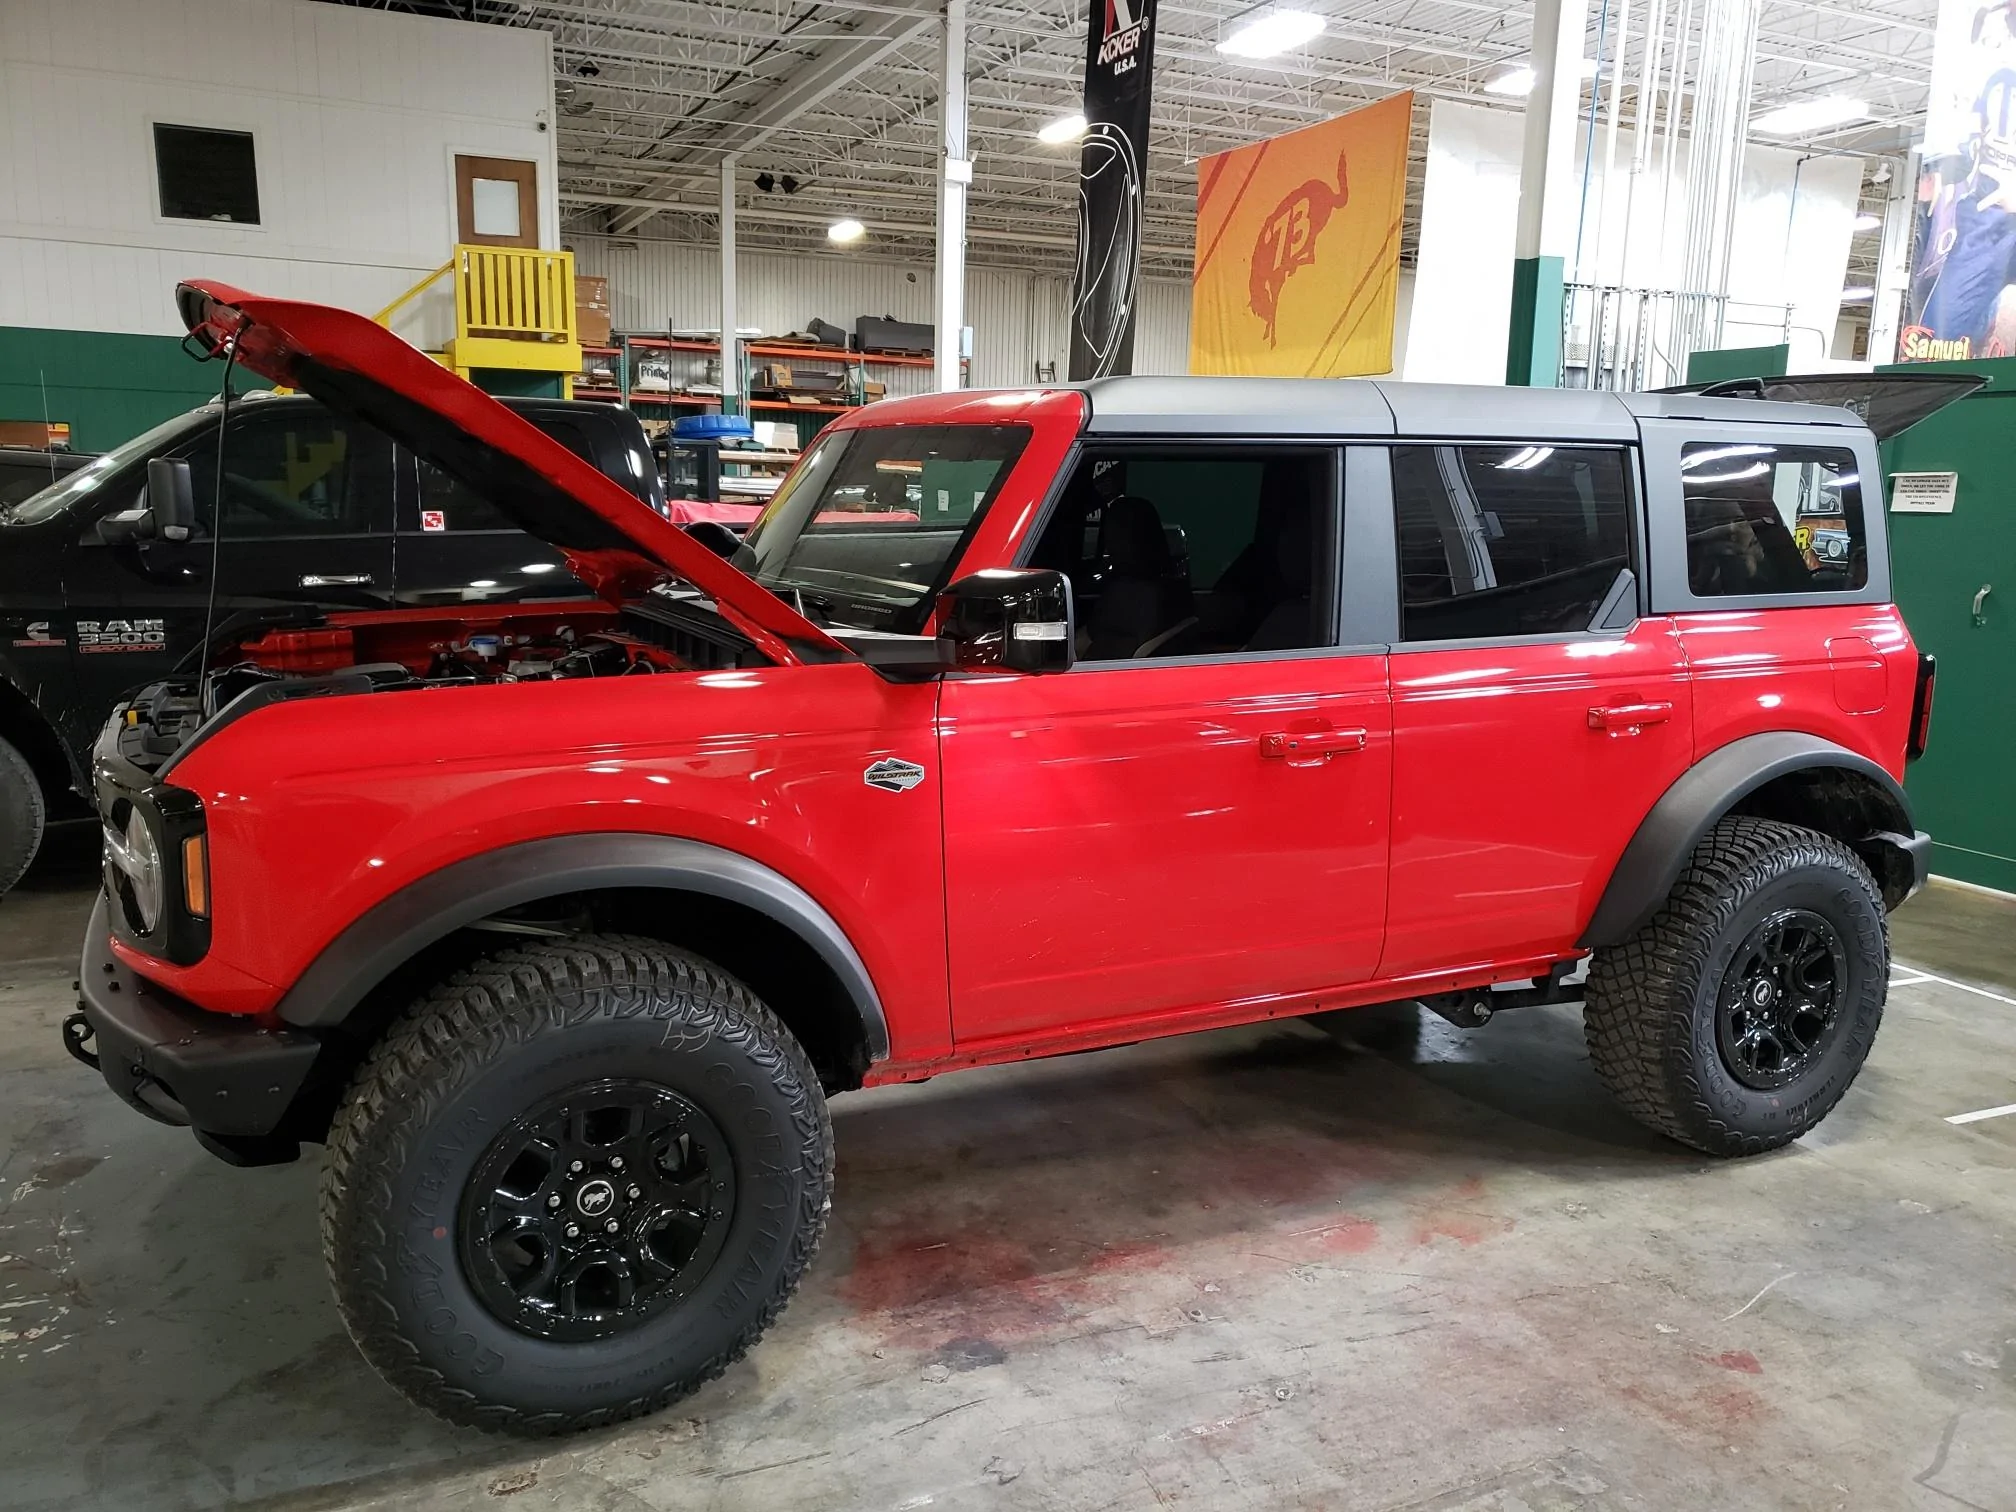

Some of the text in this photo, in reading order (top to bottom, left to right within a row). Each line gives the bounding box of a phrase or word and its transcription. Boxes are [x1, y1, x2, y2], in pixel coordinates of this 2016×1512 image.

[1905, 333, 1969, 360] Samuel
[641, 365, 670, 380] Printer
[77, 618, 164, 632] RAM
[78, 632, 165, 645] 3500
